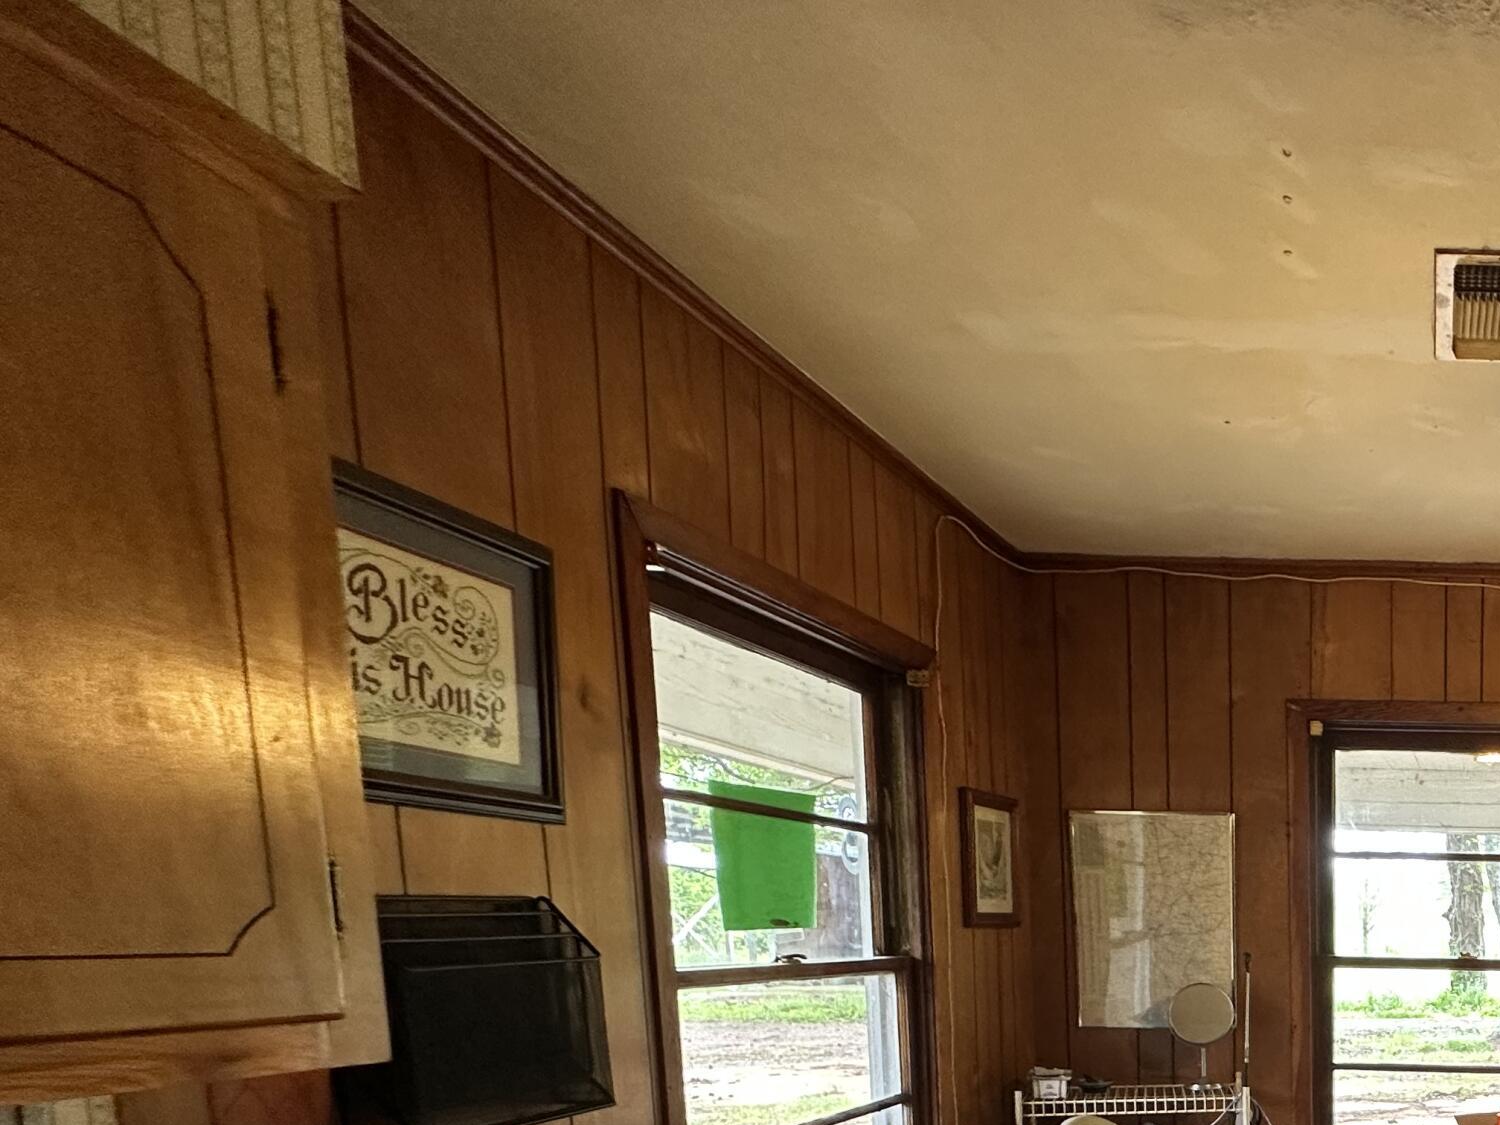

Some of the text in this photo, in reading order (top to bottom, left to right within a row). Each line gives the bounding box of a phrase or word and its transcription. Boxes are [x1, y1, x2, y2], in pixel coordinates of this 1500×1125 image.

[347, 563, 469, 648] Bless
[349, 648, 506, 724] is House
